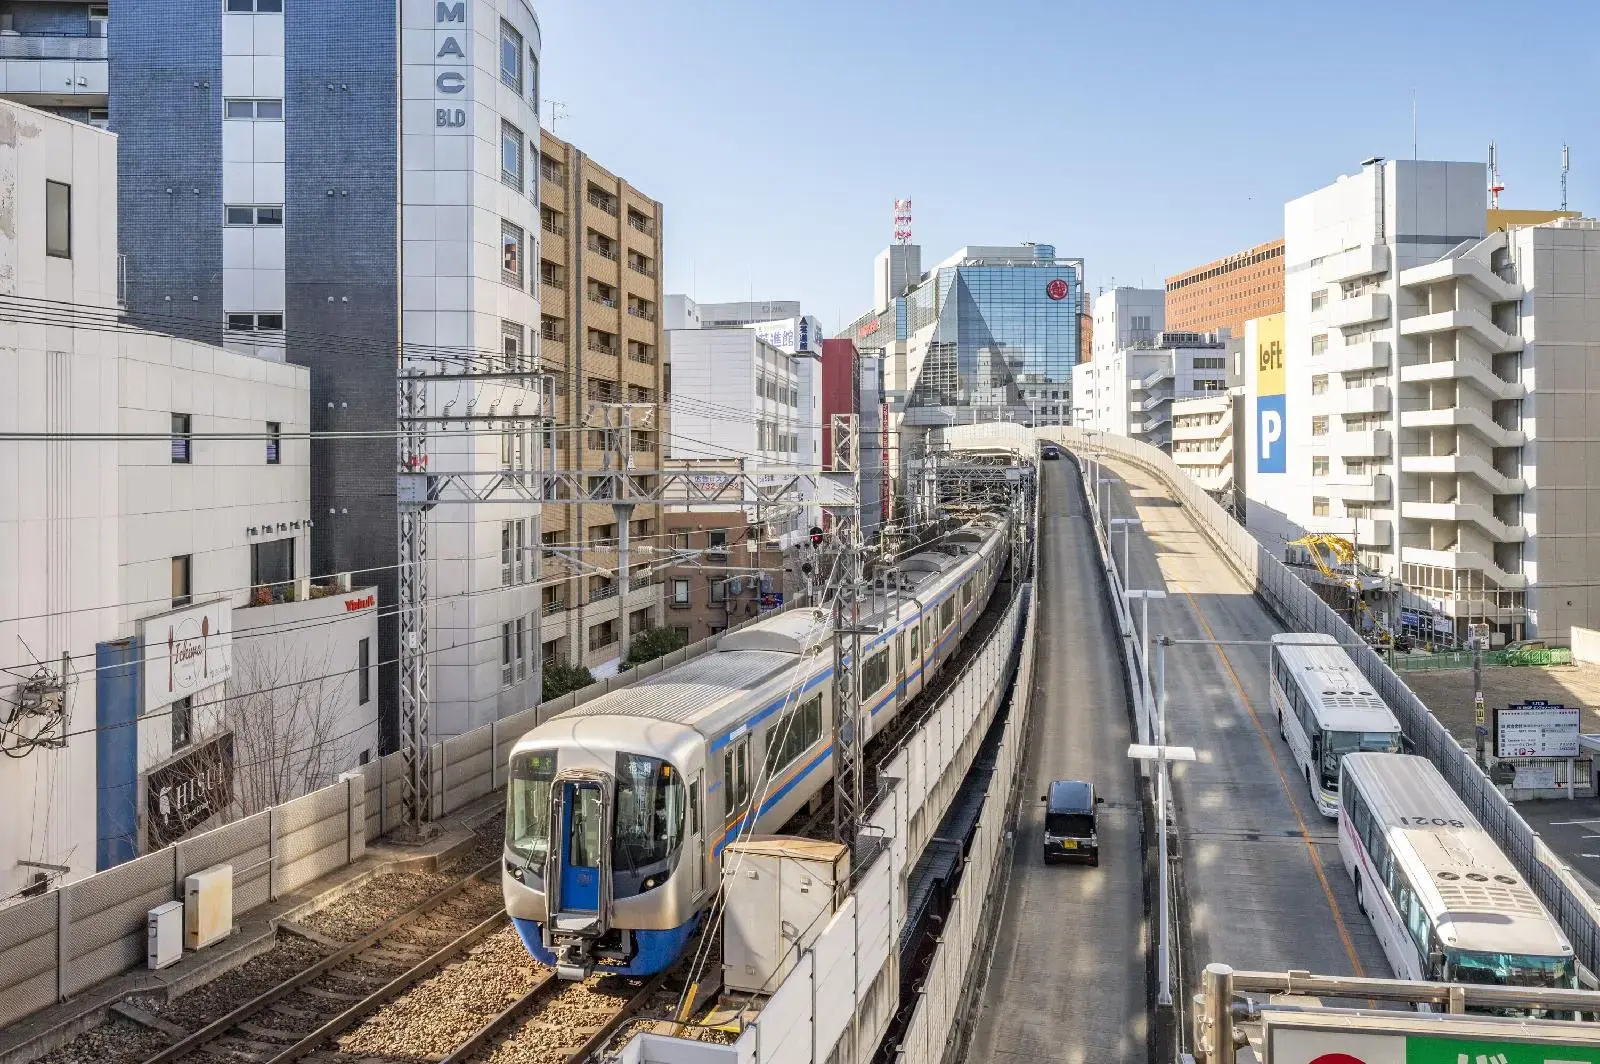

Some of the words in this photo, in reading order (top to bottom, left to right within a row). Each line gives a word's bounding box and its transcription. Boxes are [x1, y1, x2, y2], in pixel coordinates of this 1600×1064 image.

[436, 1, 465, 94] MAC
[436, 108, 466, 128] BLD
[1261, 410, 1282, 459] P
[1400, 816, 1464, 829] 8021
